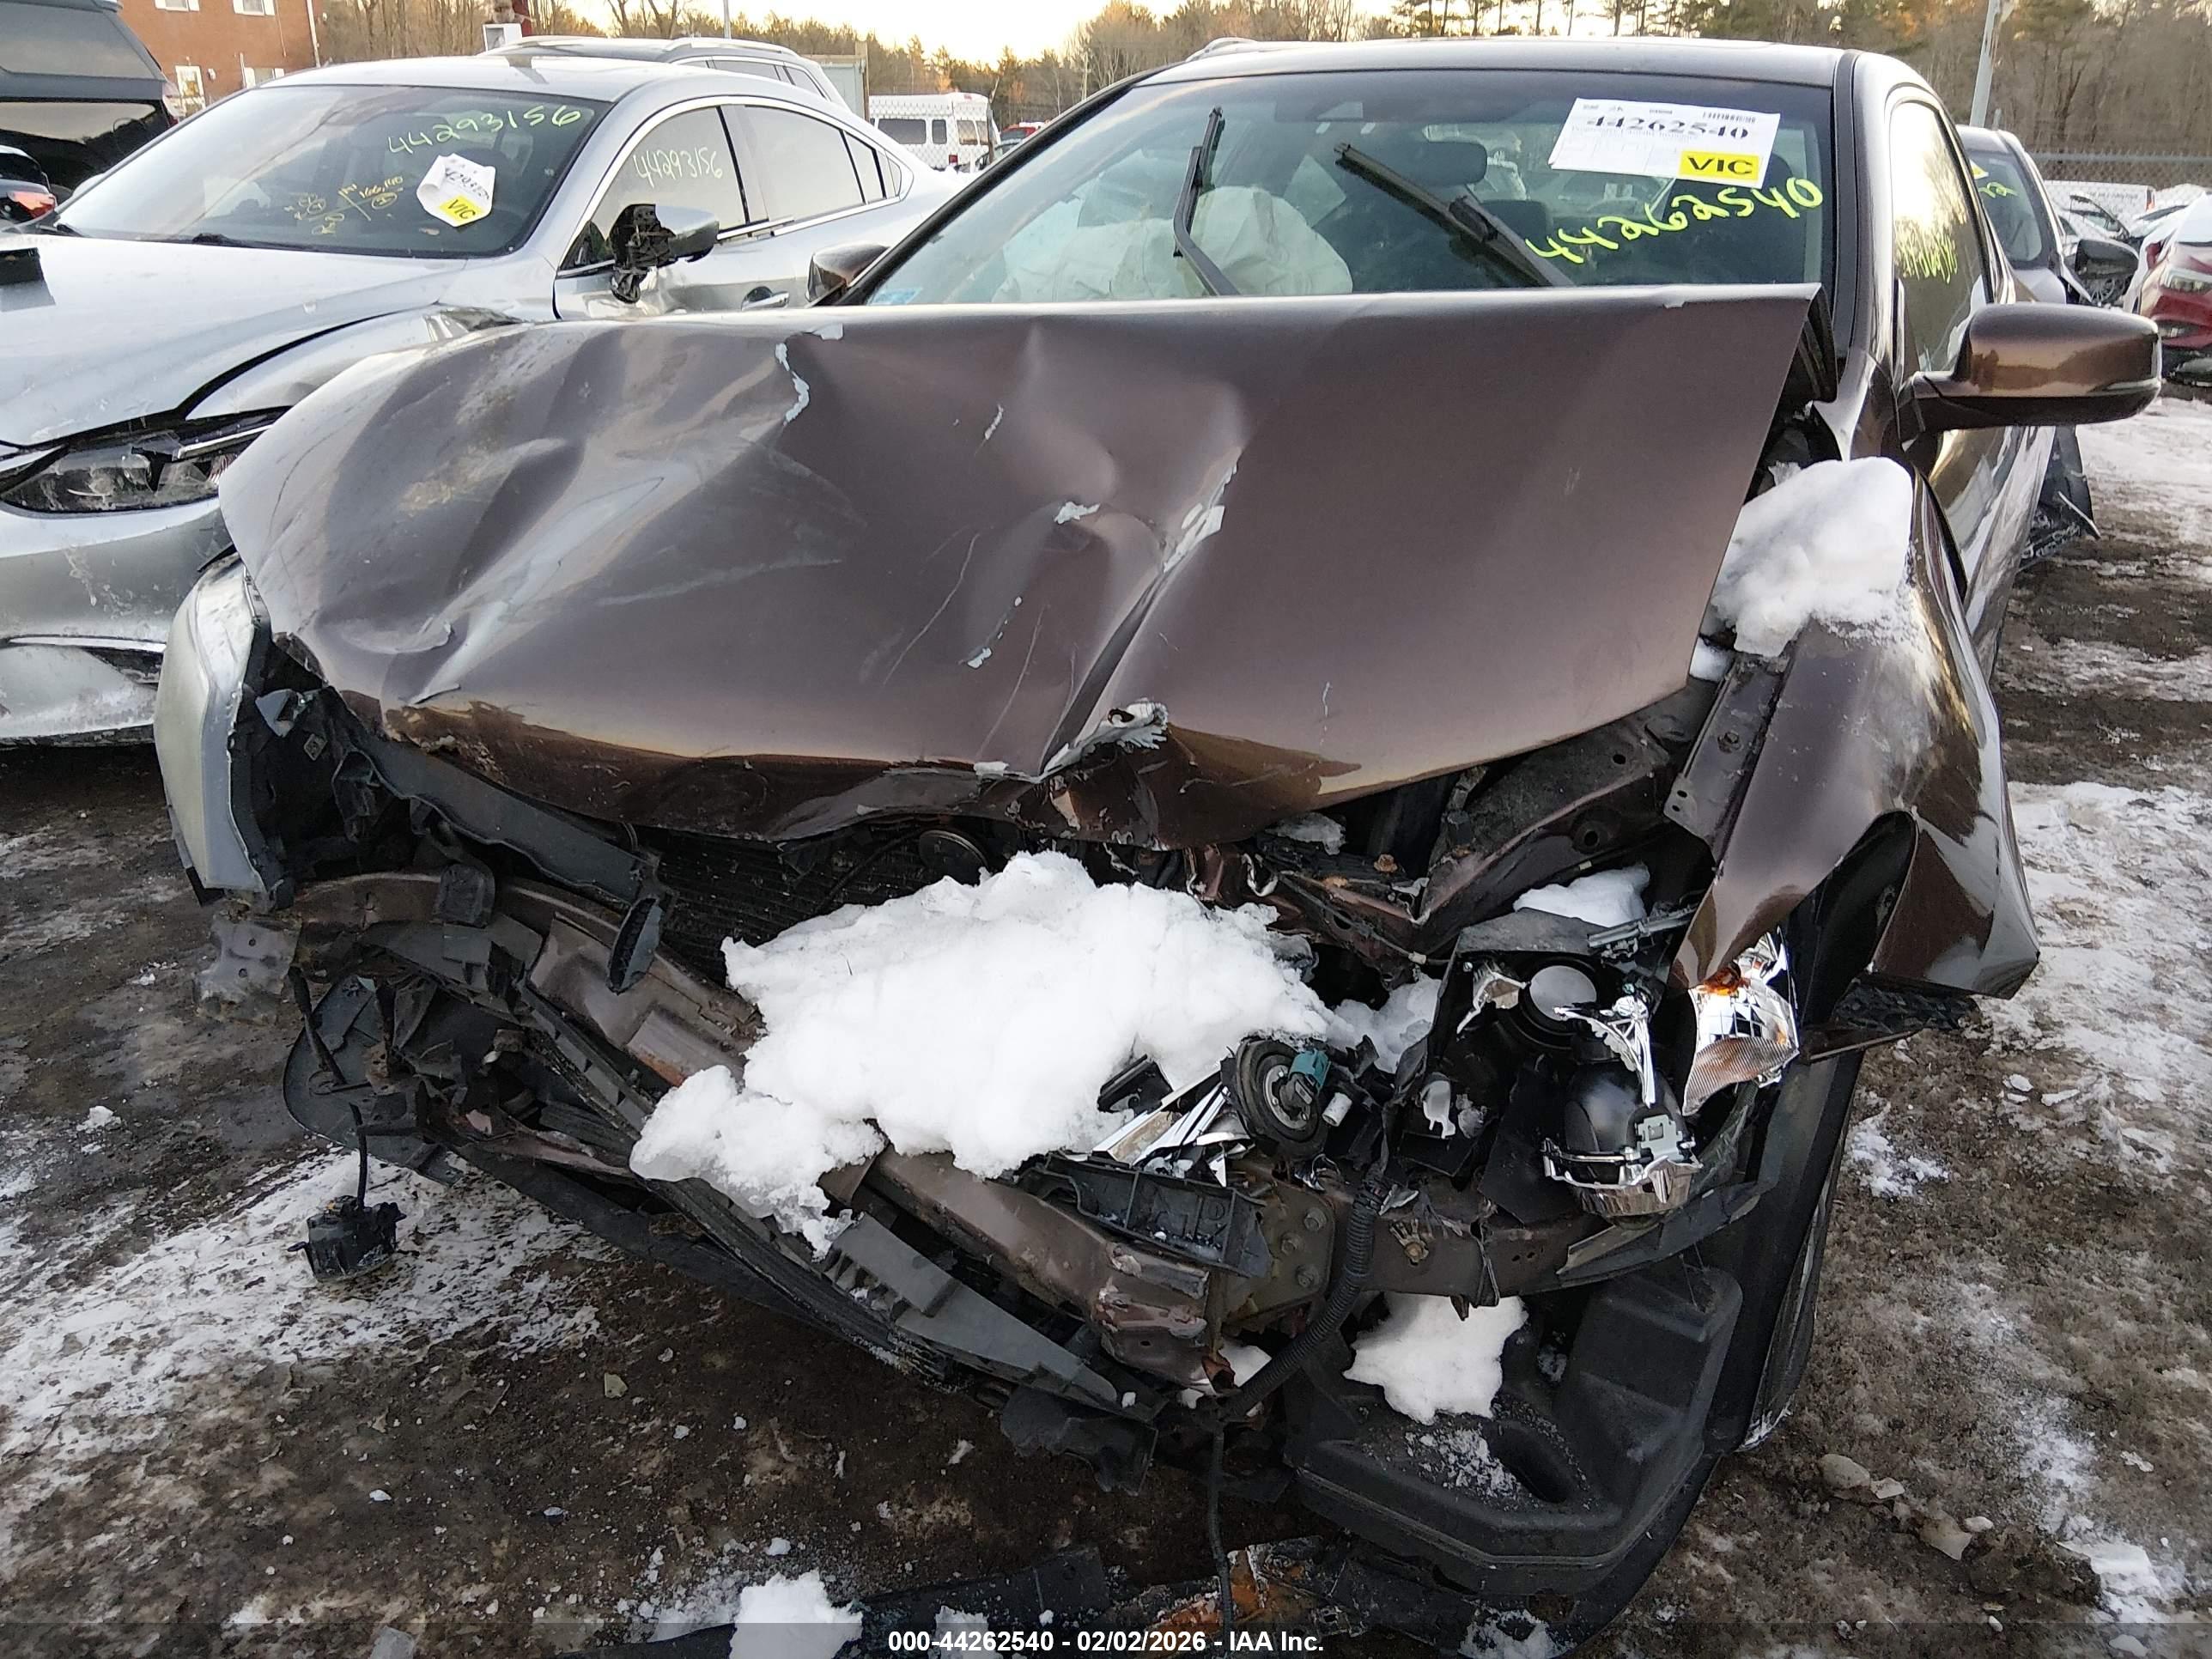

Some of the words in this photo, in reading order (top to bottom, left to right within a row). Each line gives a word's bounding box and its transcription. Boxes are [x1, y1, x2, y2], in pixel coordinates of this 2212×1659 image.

[387, 105, 582, 155] 44293156
[1587, 116, 1749, 139] 44262540
[633, 146, 723, 188] 44293156
[1687, 156, 1753, 175] VIC
[447, 198, 477, 220] VIC
[1525, 177, 1824, 264] 44262540
